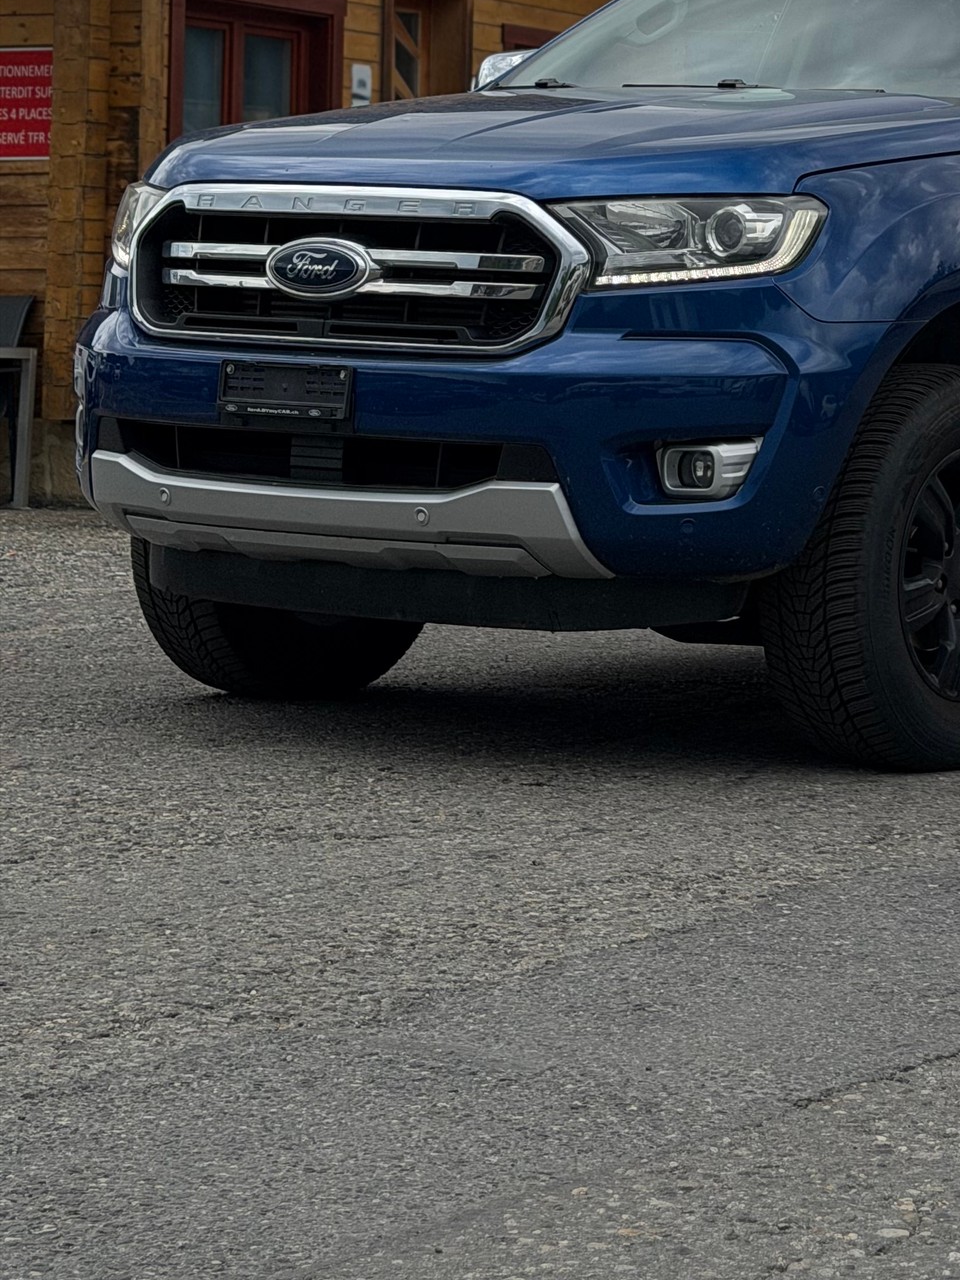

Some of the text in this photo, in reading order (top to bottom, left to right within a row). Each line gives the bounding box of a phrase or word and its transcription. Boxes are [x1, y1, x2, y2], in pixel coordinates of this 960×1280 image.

[10, 108, 17, 120] 4
[20, 107, 52, 120] PLACES
[0, 129, 25, 144] ERVÉ
[197, 193, 478, 215] RANGER
[286, 250, 340, 280] Ford
